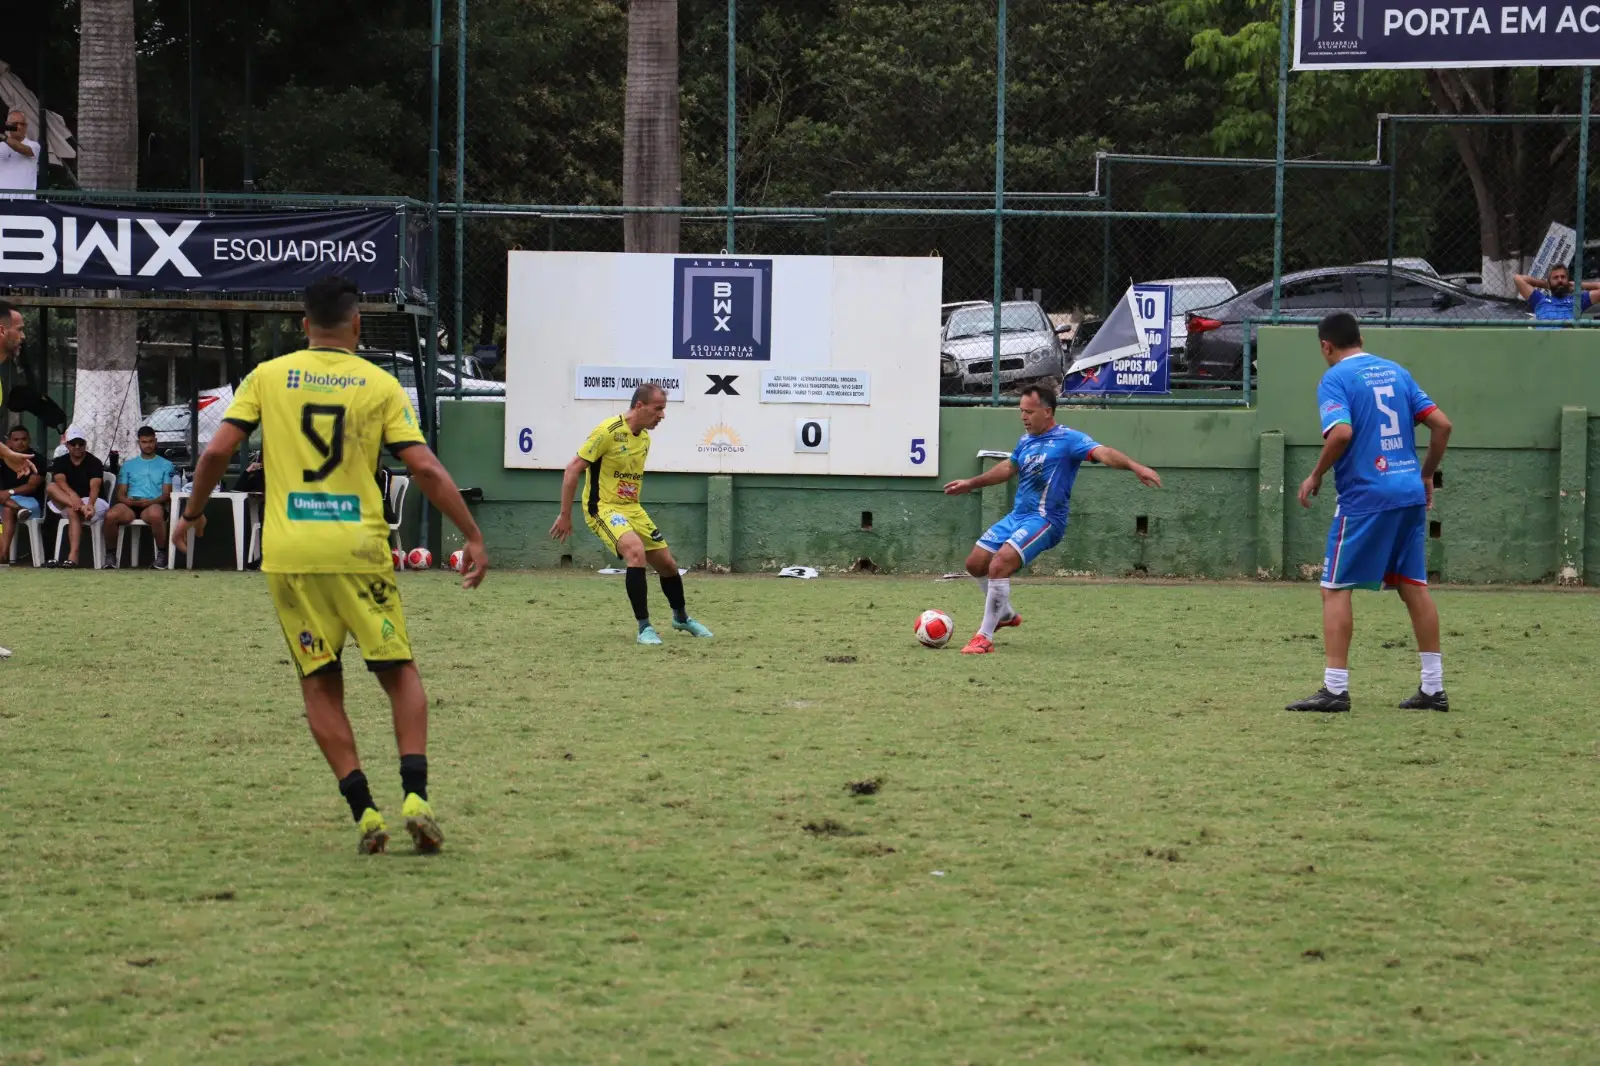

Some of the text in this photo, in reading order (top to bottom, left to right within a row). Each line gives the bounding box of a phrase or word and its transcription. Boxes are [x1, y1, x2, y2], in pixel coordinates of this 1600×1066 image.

[1333, 1, 1345, 33] BWX
[1384, 7, 1498, 36] PORTA
[1501, 6, 1547, 34] EM
[0, 215, 202, 277] BWX
[213, 238, 377, 263] ESQUADRIAS
[713, 281, 732, 331] BWX
[690, 345, 753, 353] ESQUADRIAS
[304, 370, 366, 389] biológica
[1113, 360, 1158, 373] COPOS NO
[1116, 373, 1152, 386] CAMPO.
[584, 376, 600, 388] BOOM
[601, 377, 615, 388] BETS
[1372, 385, 1400, 437] 5
[301, 402, 346, 483] 9
[518, 427, 533, 454] 6
[801, 421, 822, 448] 0
[1380, 437, 1403, 451] RENAN
[910, 438, 926, 465] 5
[294, 498, 339, 510] Unimed
